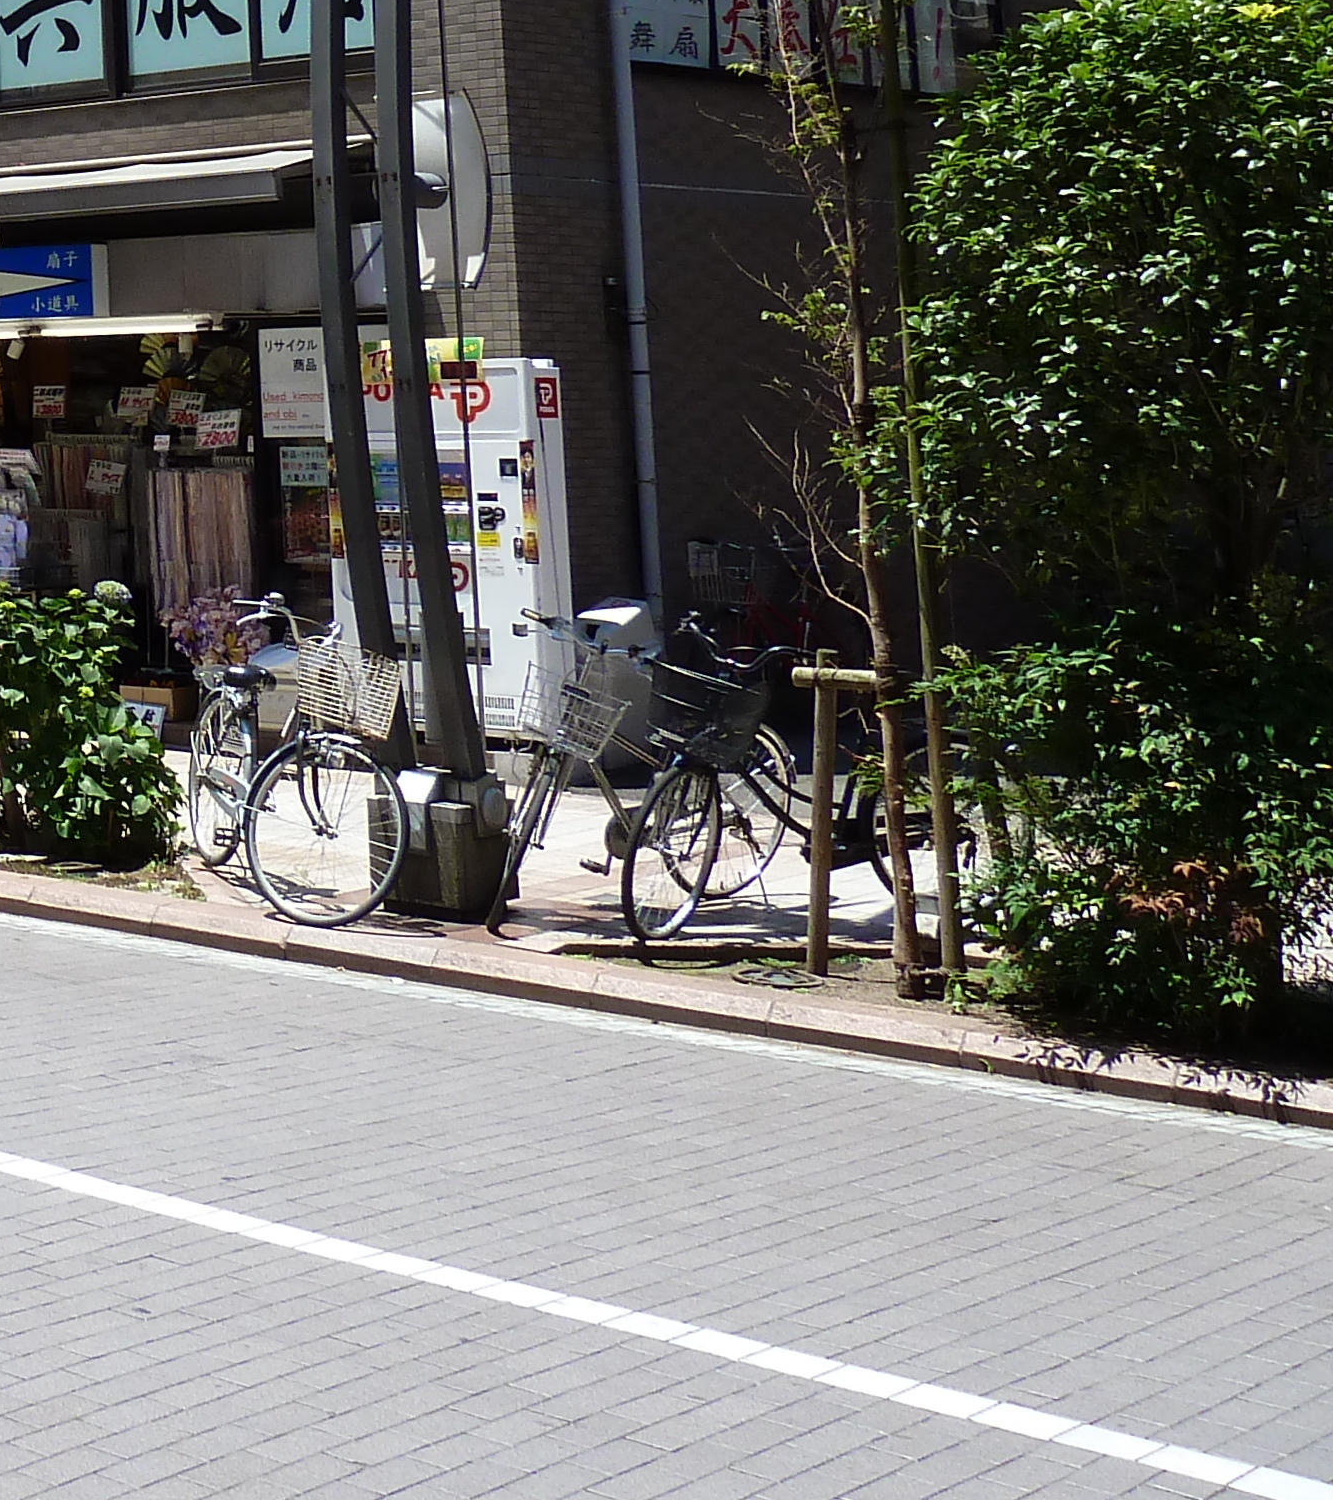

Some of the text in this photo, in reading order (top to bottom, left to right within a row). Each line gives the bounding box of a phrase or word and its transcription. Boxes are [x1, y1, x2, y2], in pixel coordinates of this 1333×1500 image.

[629, 20, 700, 61] 舞扇
[46, 250, 78, 269] 扇子
[31, 294, 79, 313] 小道具
[264, 339, 318, 353] リサイクル
[293, 357, 317, 372] 商品
